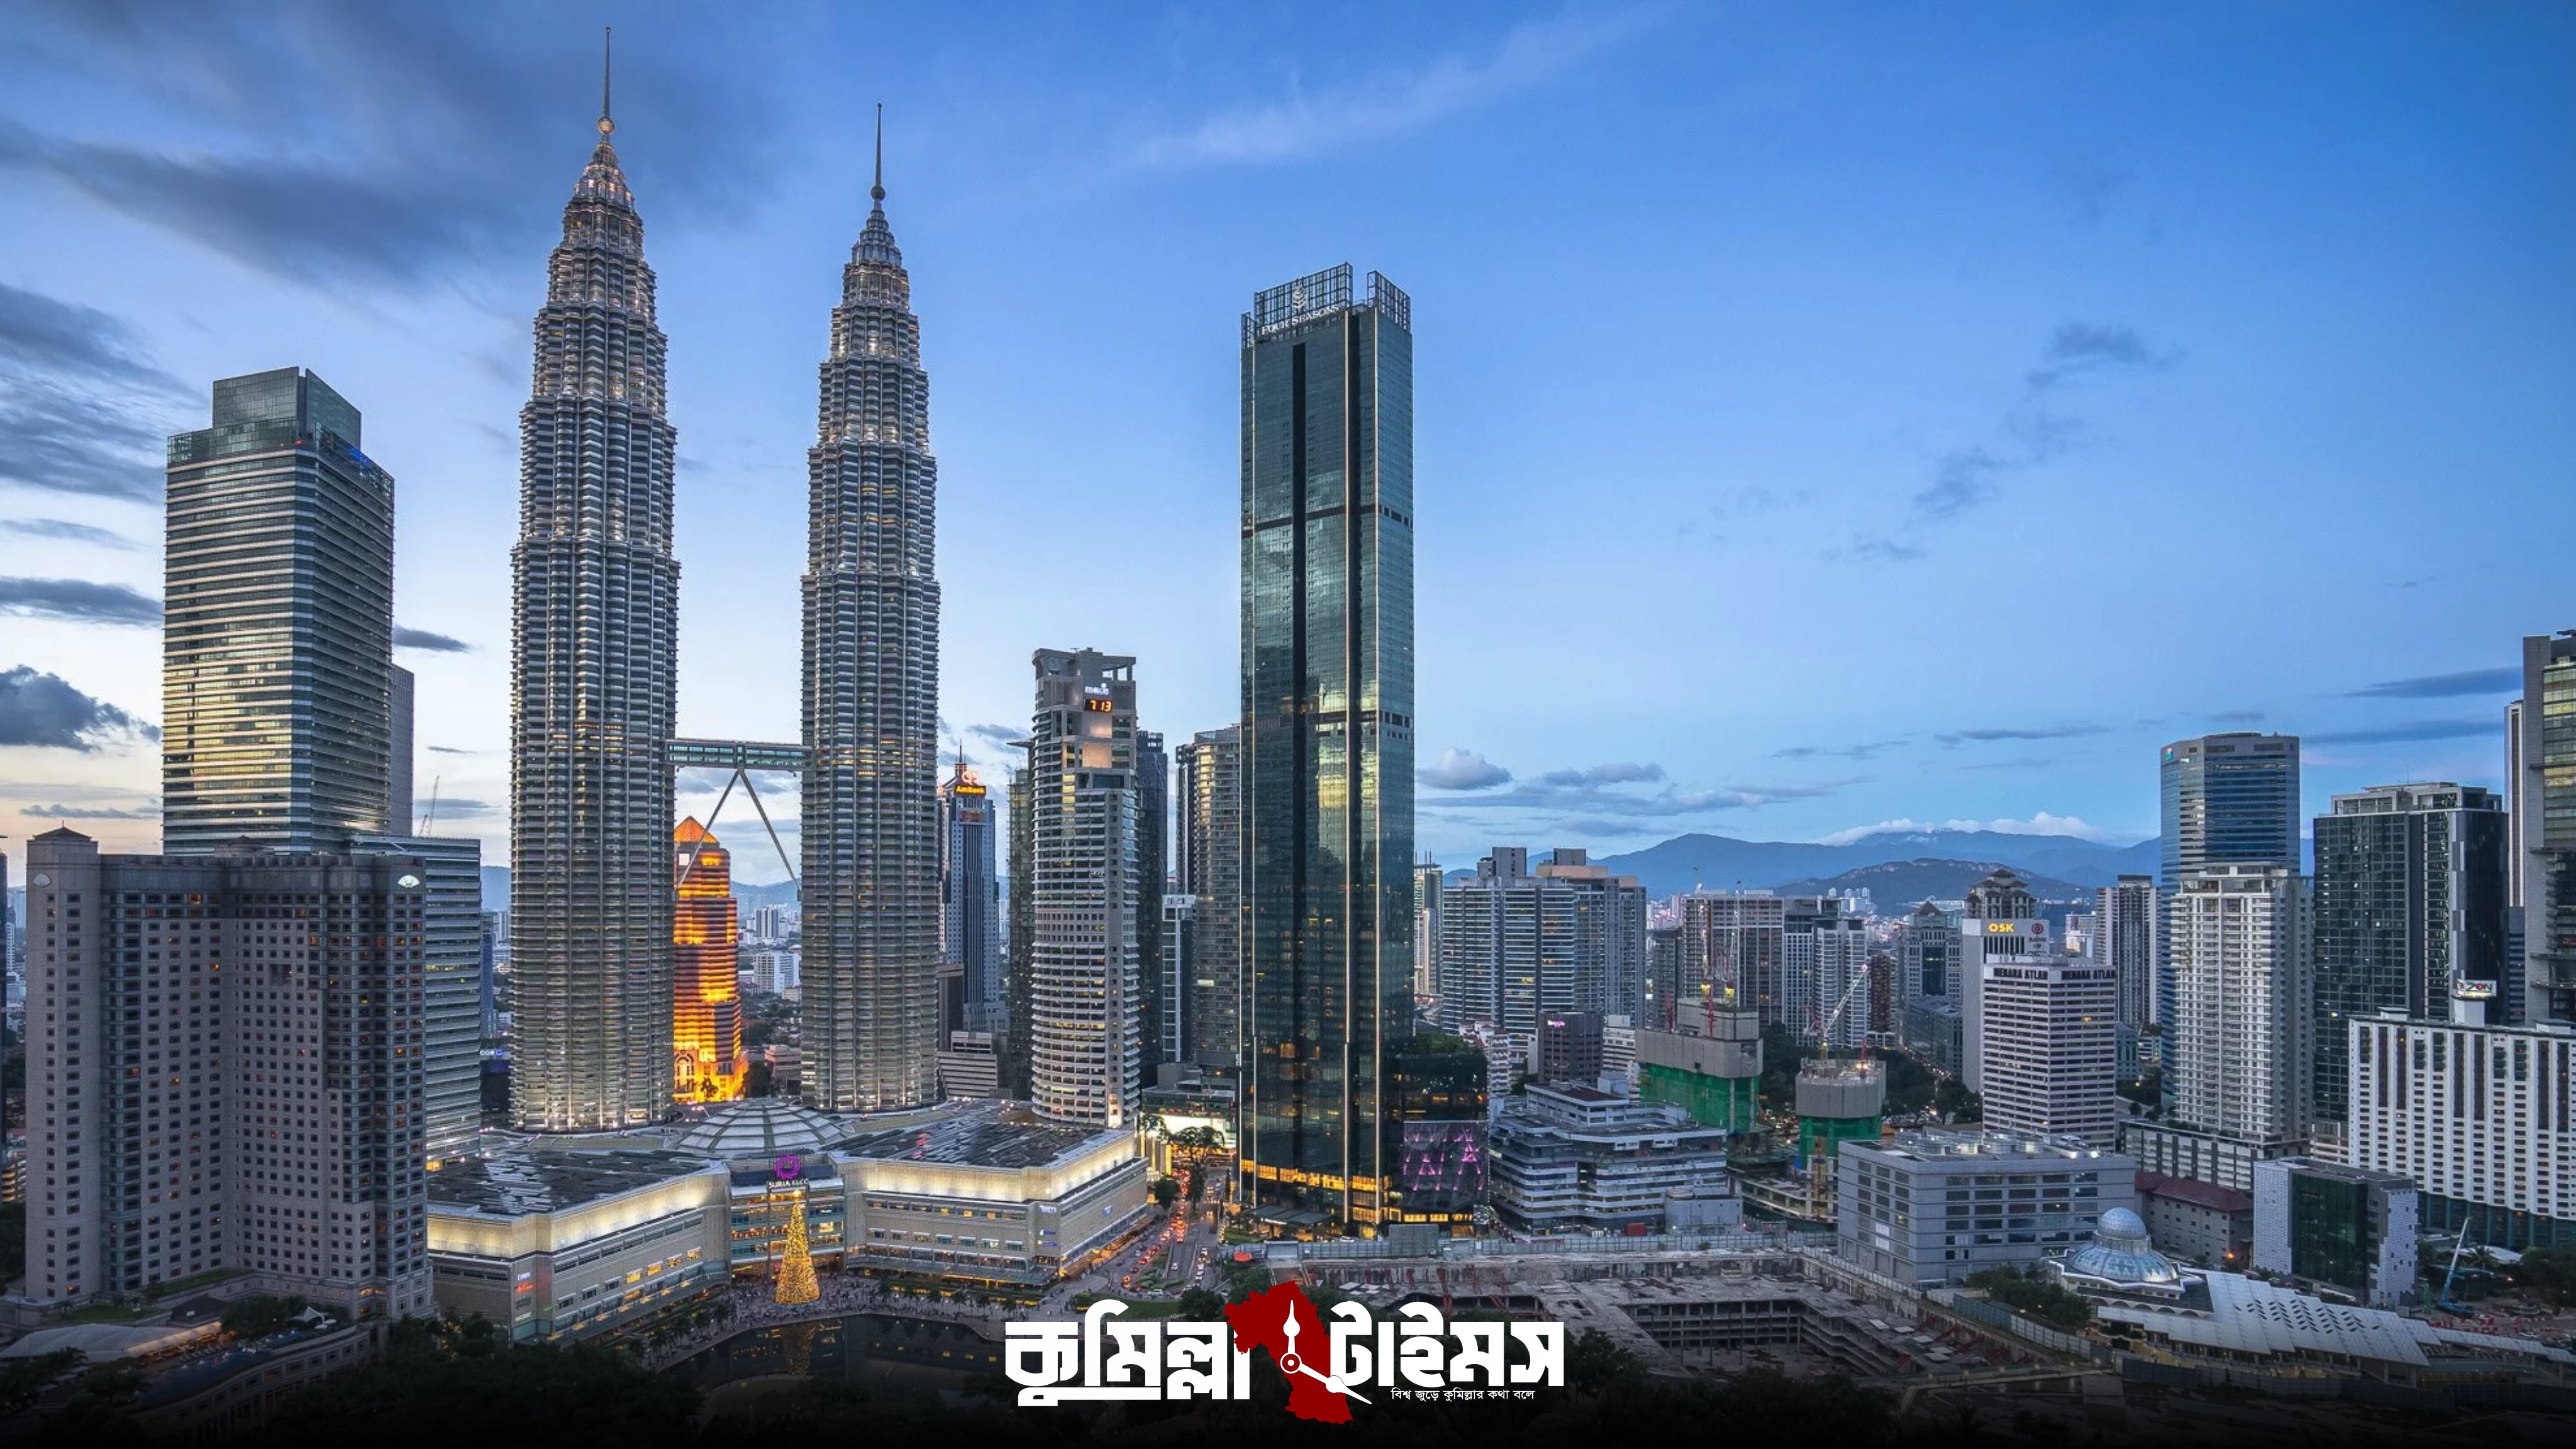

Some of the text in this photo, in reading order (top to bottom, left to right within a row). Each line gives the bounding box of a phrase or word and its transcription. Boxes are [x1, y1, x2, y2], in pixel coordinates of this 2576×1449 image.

[1262, 304, 1340, 335] FOUR SEASONS
[956, 786, 985, 794] AmBank
[1989, 923, 2014, 933] OSK
[1994, 968, 2023, 979] MENARA
[2062, 970, 2091, 980] MENARA
